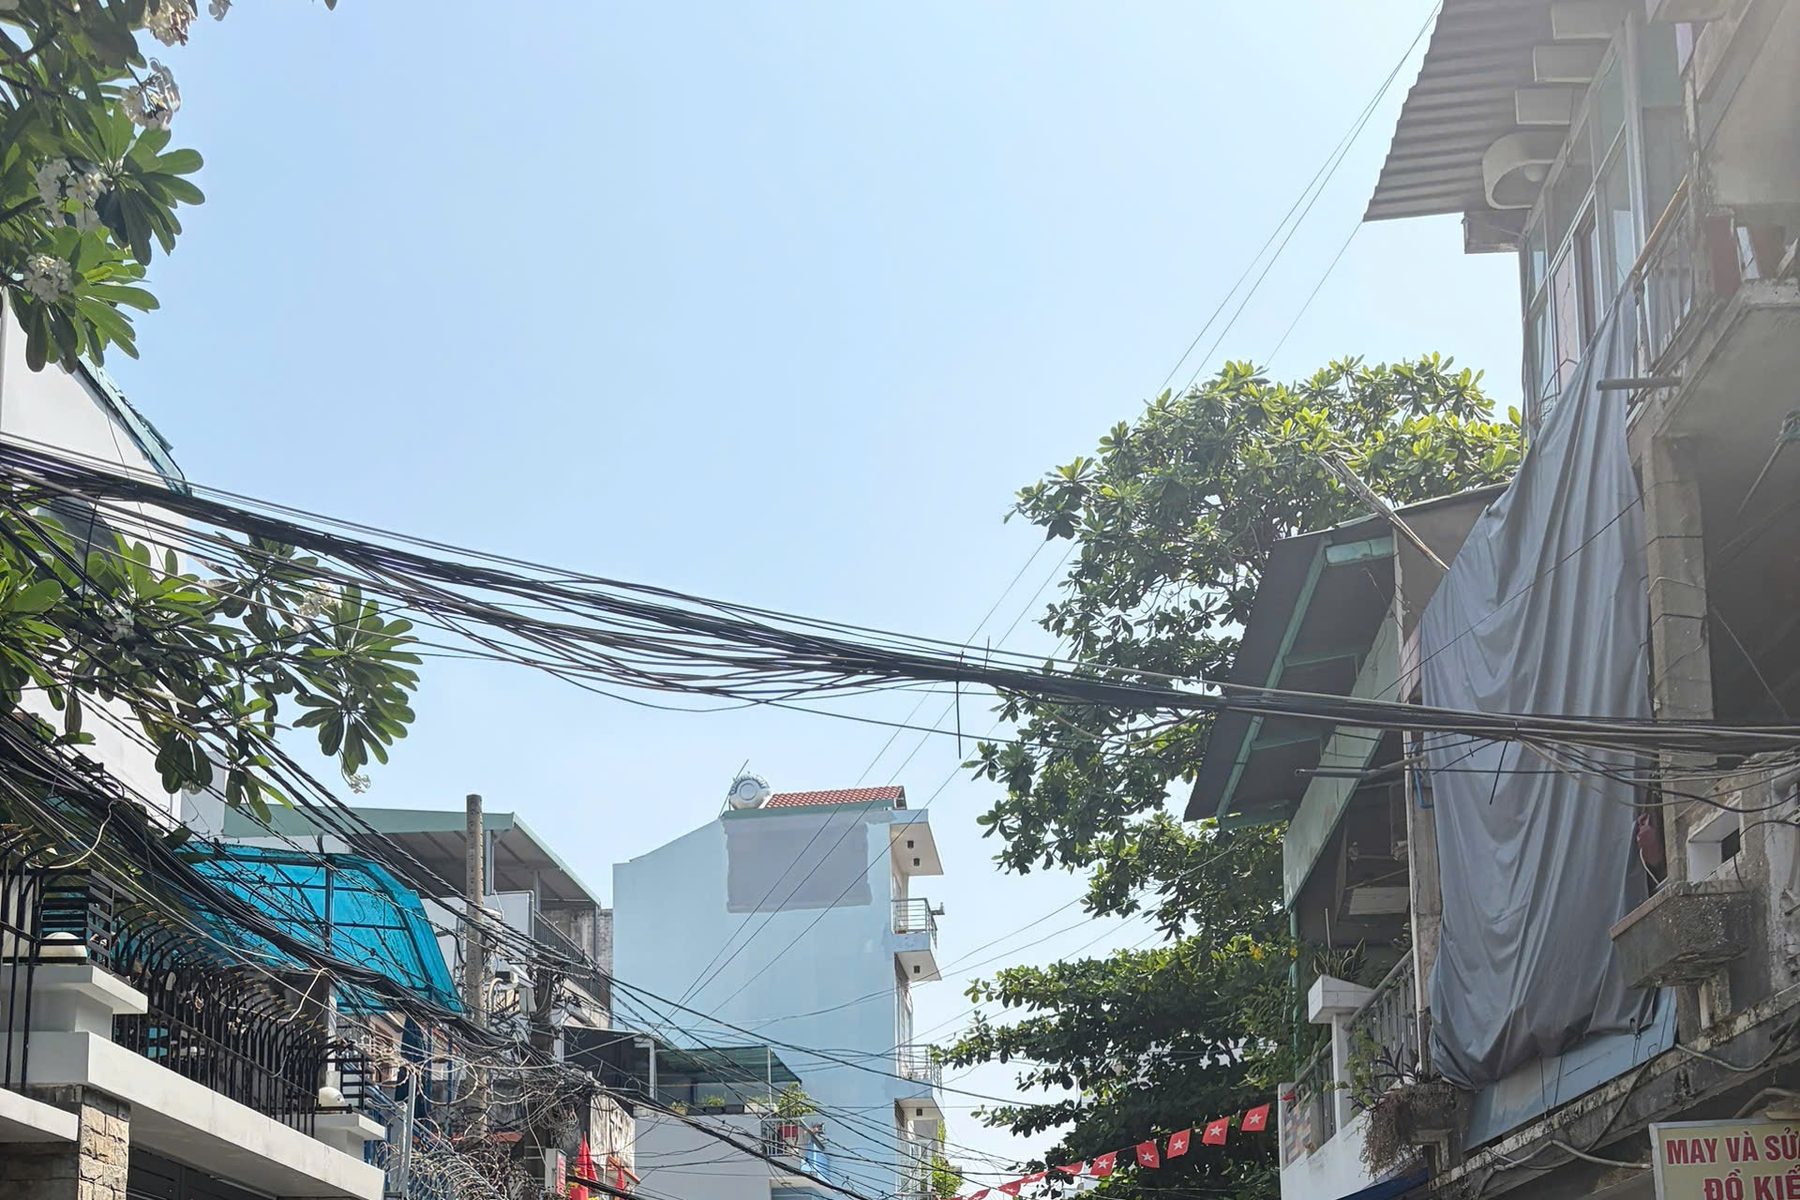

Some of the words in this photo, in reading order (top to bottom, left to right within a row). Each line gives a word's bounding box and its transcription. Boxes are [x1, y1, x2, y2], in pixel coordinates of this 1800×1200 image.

[1666, 1138, 1718, 1165] MAY
[1725, 1131, 1759, 1163] VÀ
[1764, 1126, 1800, 1161] SỬ
